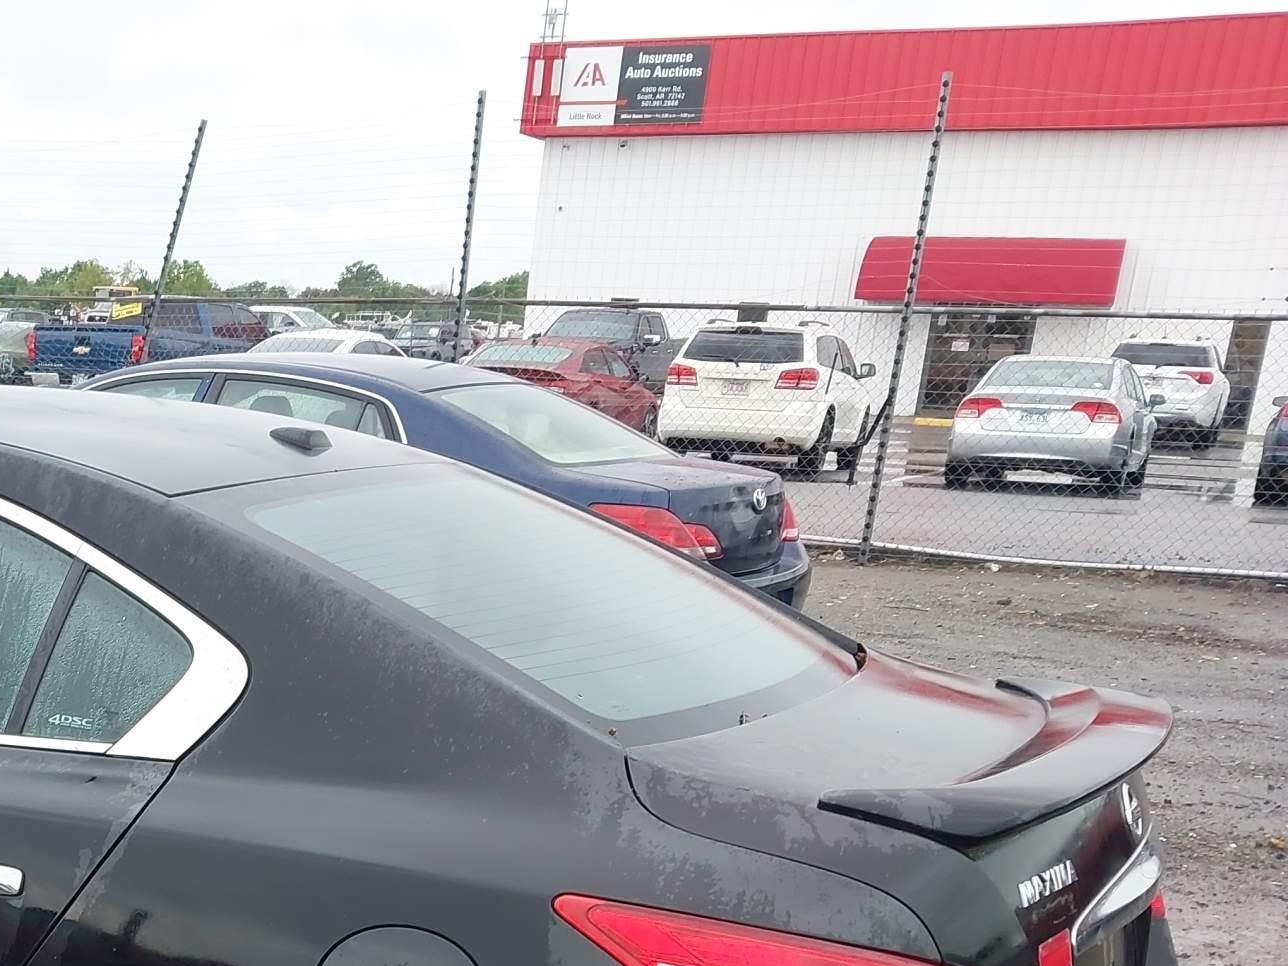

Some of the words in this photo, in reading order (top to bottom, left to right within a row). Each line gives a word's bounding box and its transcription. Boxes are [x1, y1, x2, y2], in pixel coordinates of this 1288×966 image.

[638, 52, 693, 65] Insurance
[625, 66, 652, 79] Auto
[653, 65, 703, 79] Auctions
[568, 112, 585, 120] Little
[586, 111, 602, 120] Rock
[1018, 859, 1080, 908] MAXIMA
